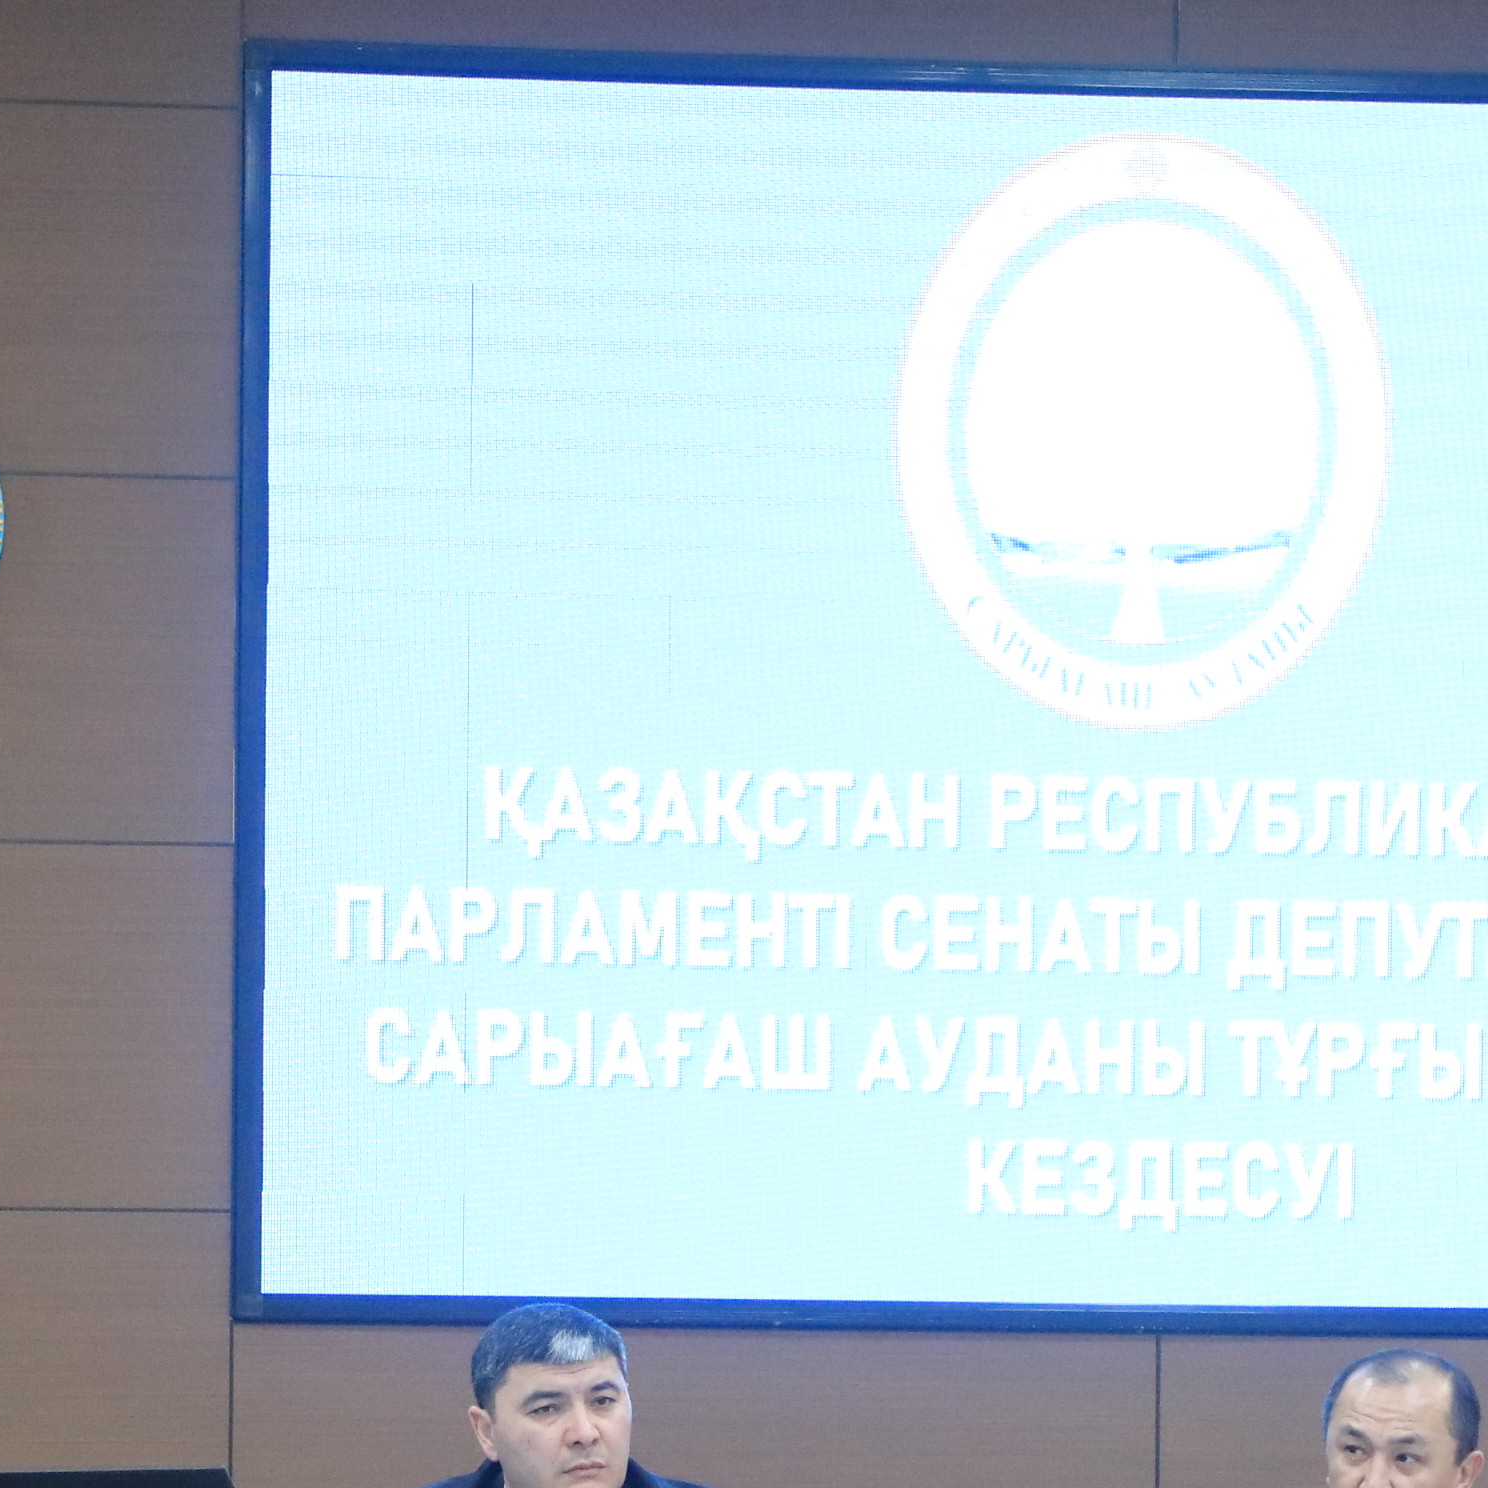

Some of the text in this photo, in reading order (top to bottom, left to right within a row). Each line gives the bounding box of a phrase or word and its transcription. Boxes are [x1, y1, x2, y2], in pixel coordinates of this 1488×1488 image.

[485, 765, 958, 862] ҚАЗАҚСТАН
[334, 883, 851, 968] ПАРЛАМЕНТІ
[880, 893, 1200, 974] СЕНАТЫ
[365, 1007, 831, 1089] САРЫАҒАШ
[857, 1015, 1204, 1108] АУДАНЫ
[967, 1138, 1353, 1230] КЕЗДЕСУІ
